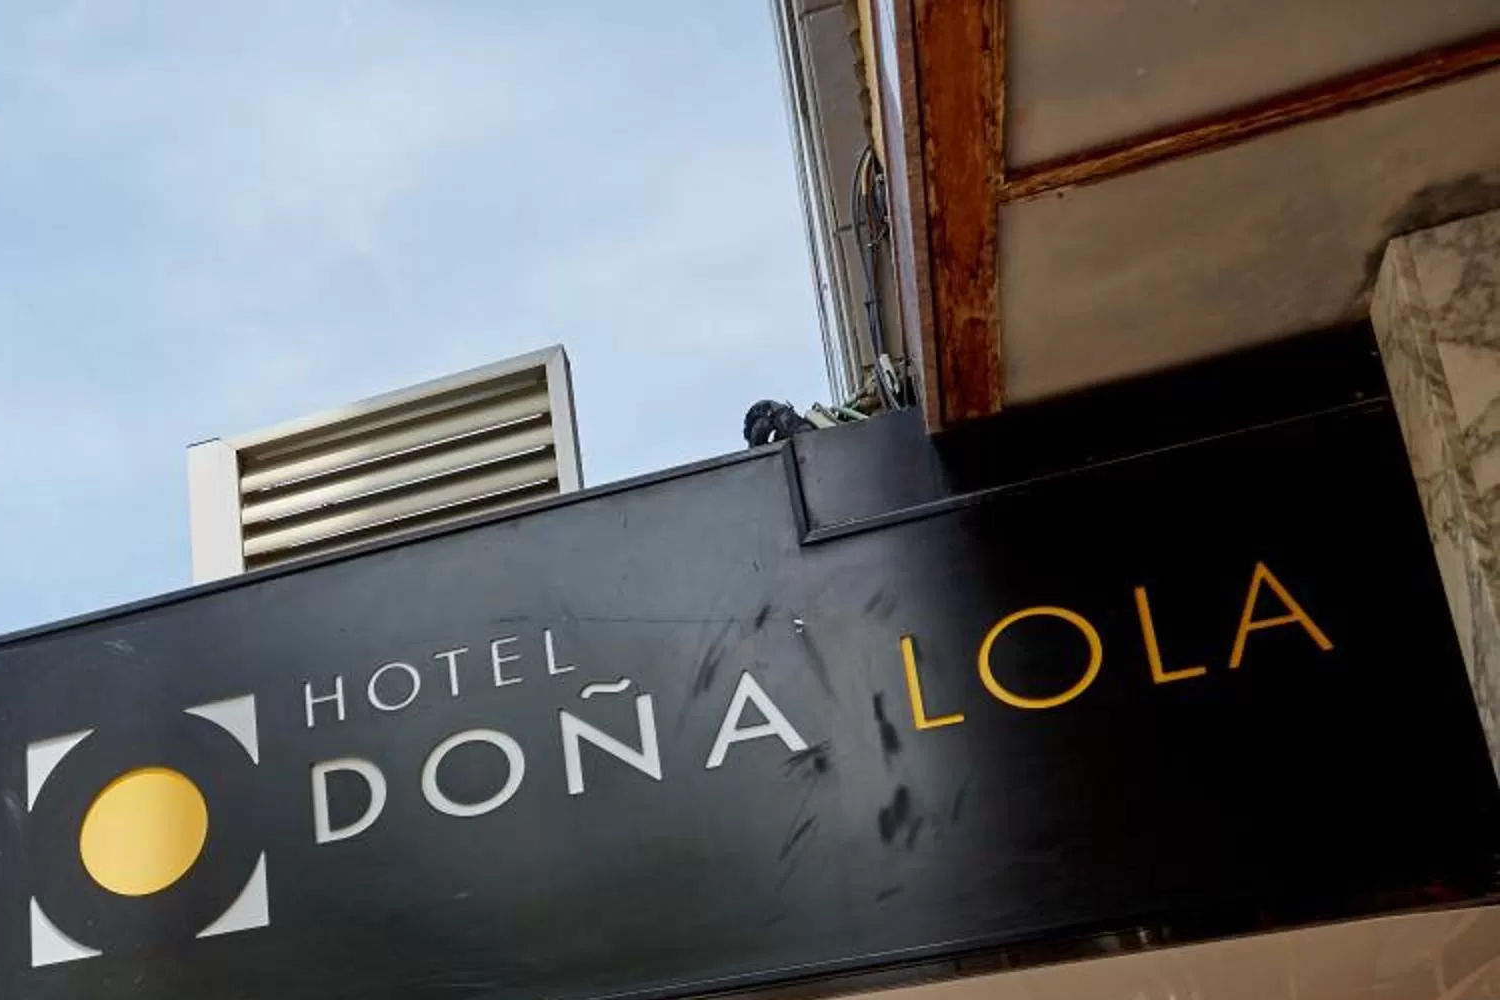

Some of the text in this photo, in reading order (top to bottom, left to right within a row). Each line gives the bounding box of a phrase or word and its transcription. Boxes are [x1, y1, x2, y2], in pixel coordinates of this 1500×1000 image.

[303, 628, 576, 728] HOTEL
[311, 560, 1335, 845] DOÑA LOLA
